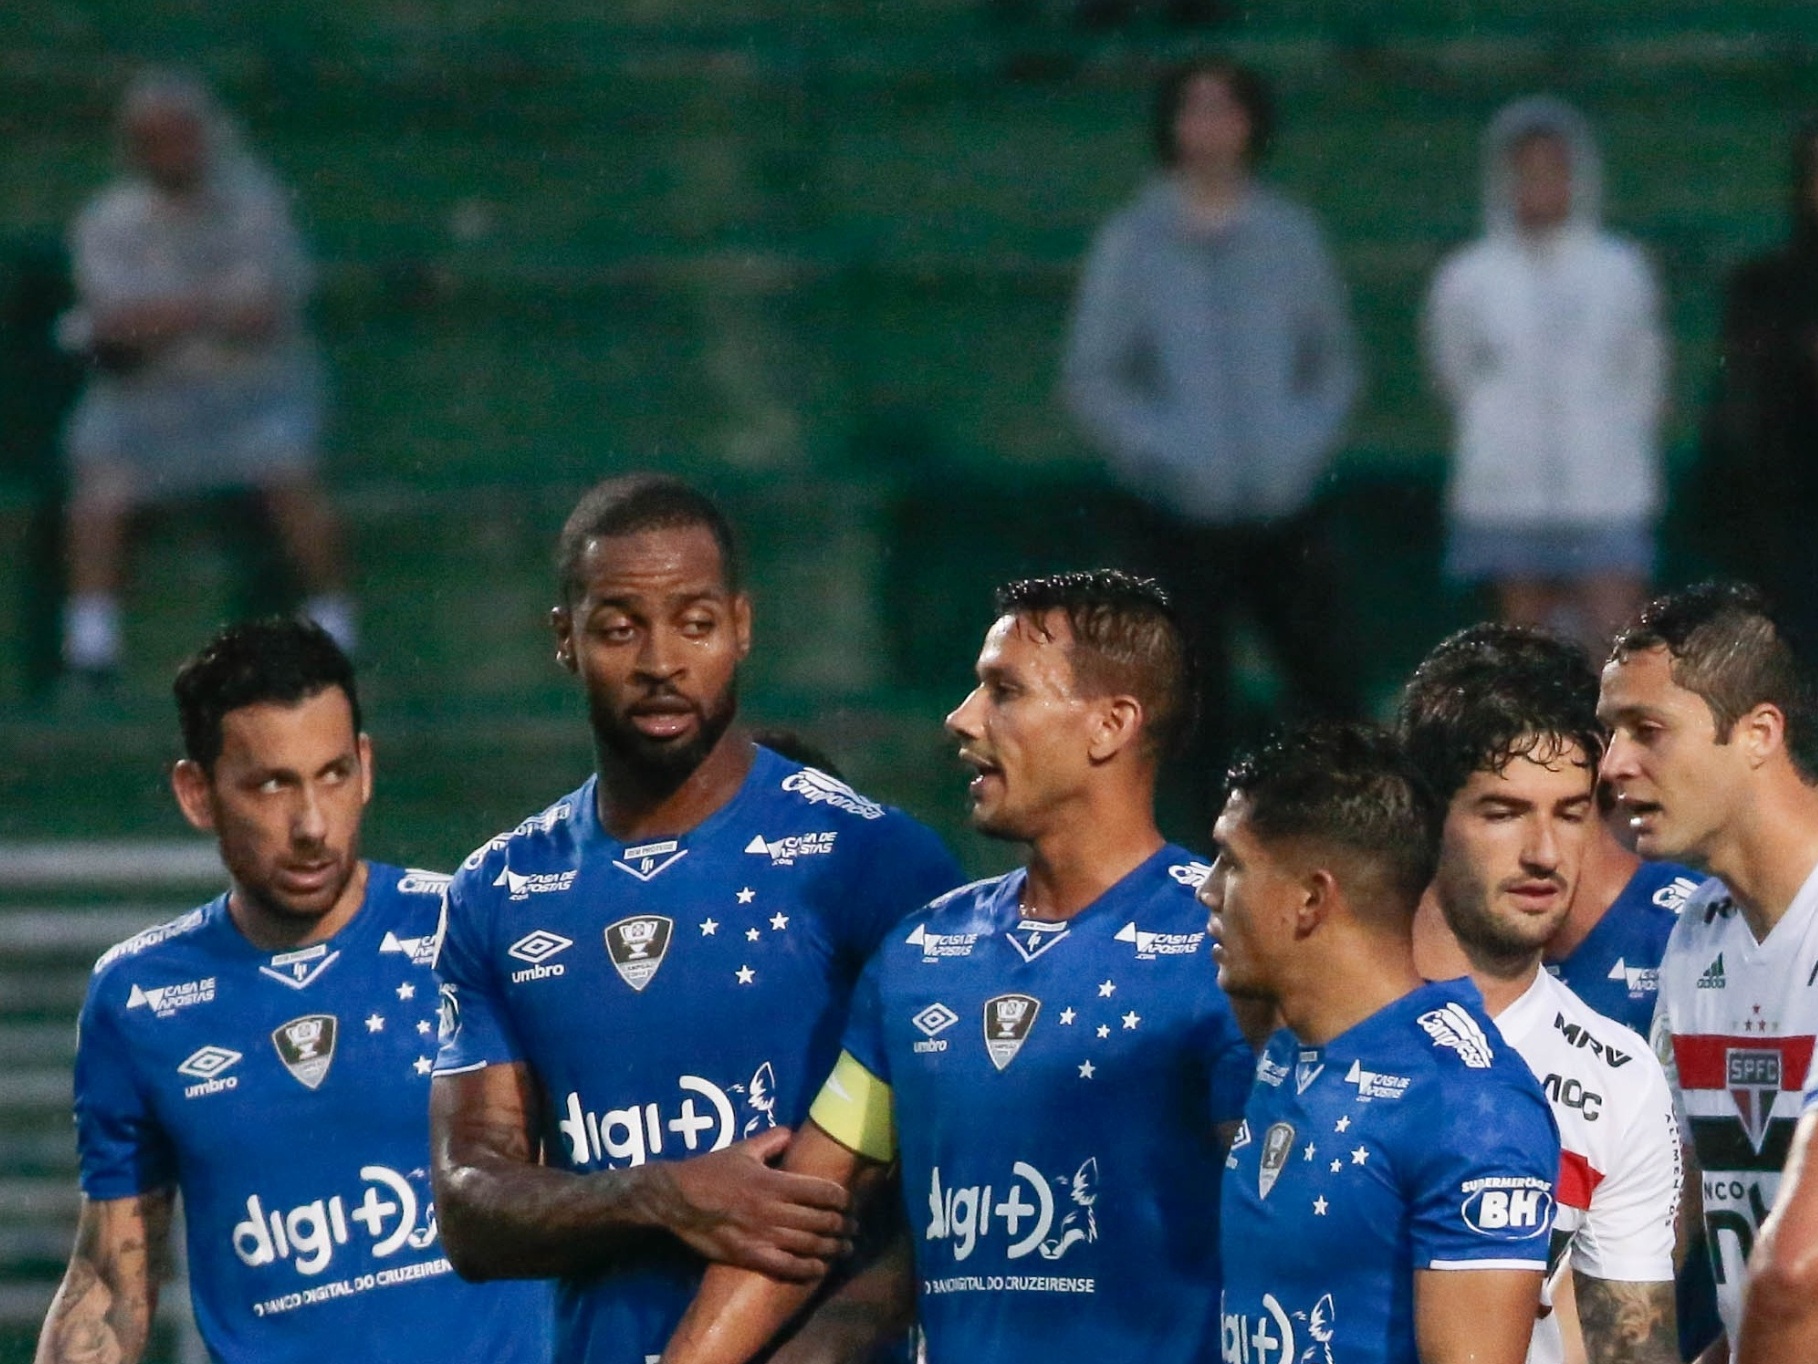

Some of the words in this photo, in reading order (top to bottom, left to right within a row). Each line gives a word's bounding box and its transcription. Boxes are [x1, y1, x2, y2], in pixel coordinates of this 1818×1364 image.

[512, 963, 565, 984] umbro
[162, 981, 199, 998] CASA
[200, 977, 216, 992] DE
[1554, 1011, 1633, 1068] MRV
[1731, 1057, 1779, 1083] SPFC
[184, 1075, 238, 1099] umbro
[1479, 1189, 1543, 1229] BH
[302, 1281, 354, 1304] DIGITAL
[354, 1273, 377, 1292] DO
